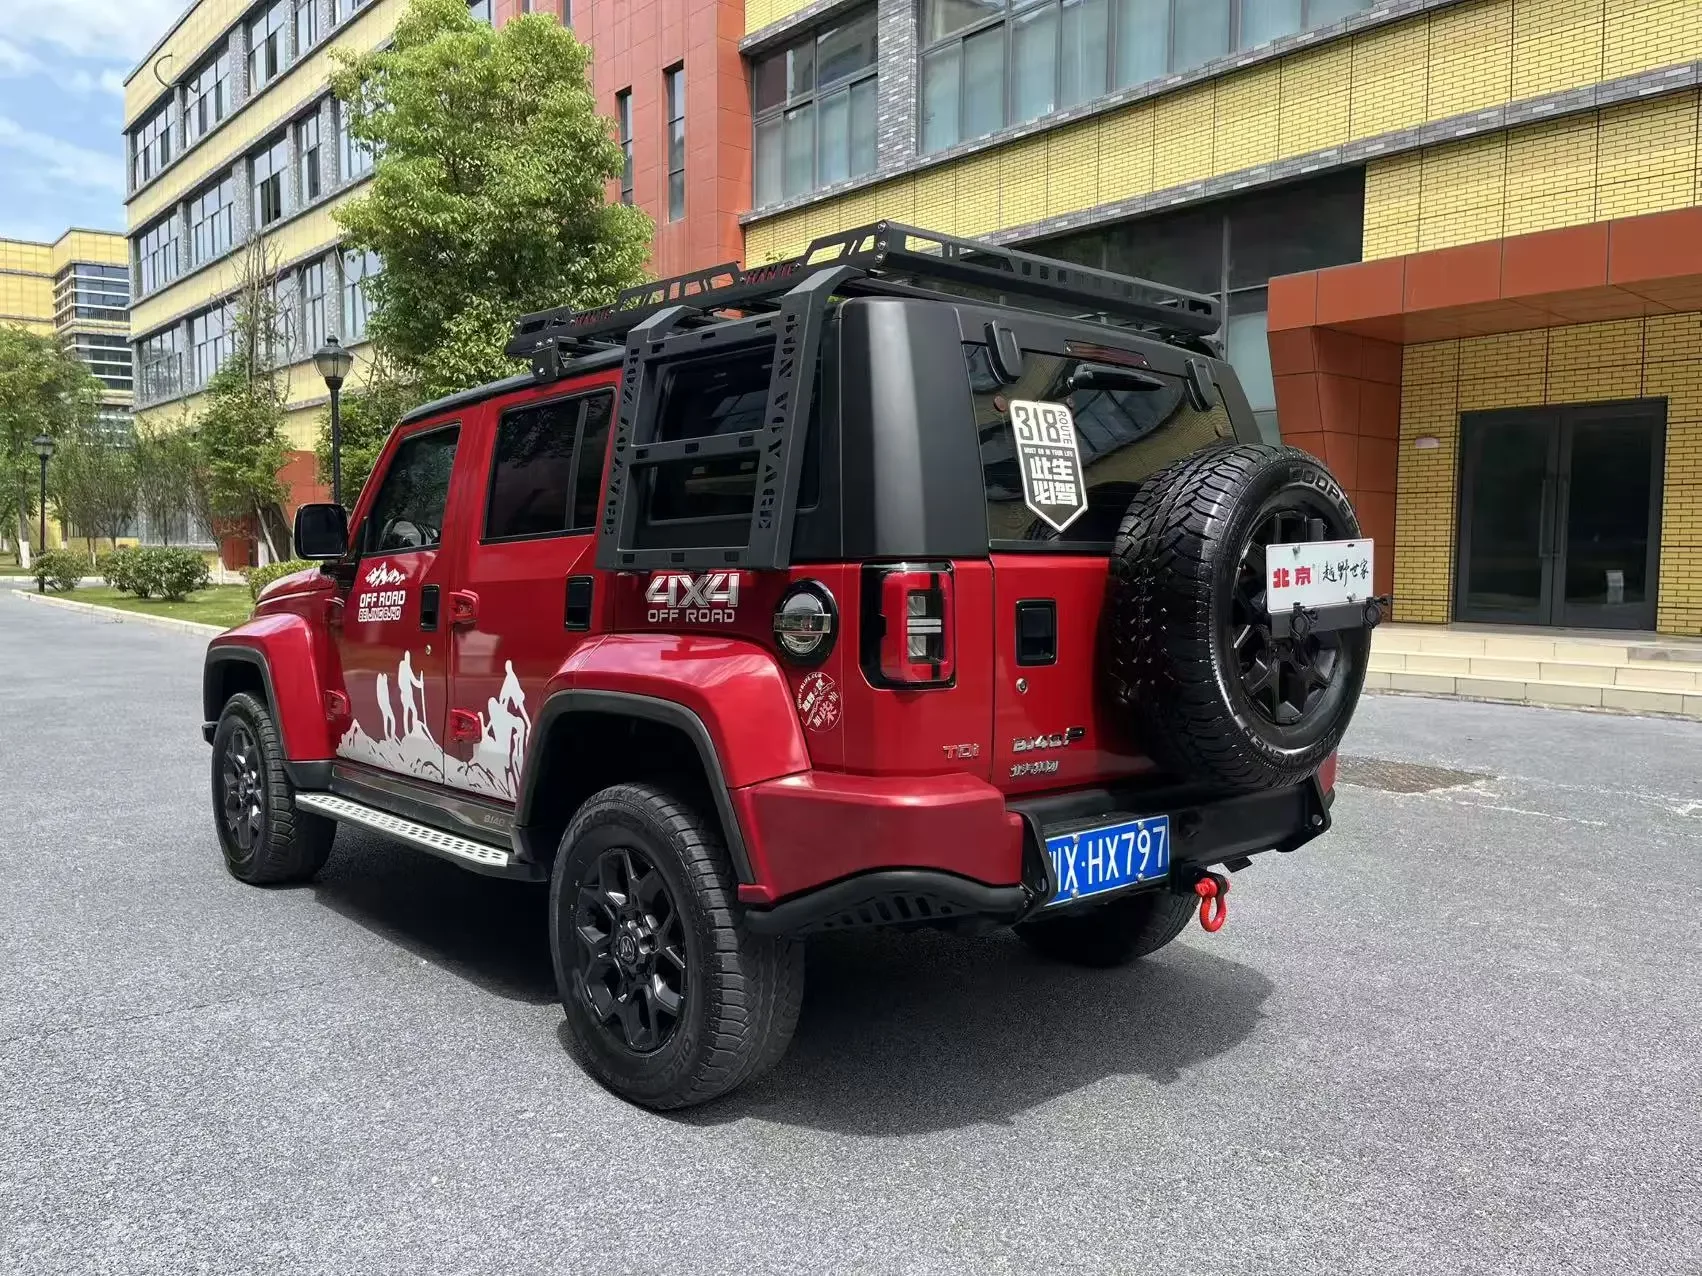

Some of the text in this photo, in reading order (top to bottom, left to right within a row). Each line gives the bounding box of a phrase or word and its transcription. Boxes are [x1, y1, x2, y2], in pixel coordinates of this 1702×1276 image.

[1015, 406, 1062, 443] 318
[1059, 410, 1073, 446] ROUTE
[1029, 456, 1074, 481] 此生
[1273, 566, 1312, 588] 北京
[360, 590, 406, 608] OFF ROAD
[645, 573, 740, 608] 4X4
[648, 609, 735, 622] OFF ROAD
